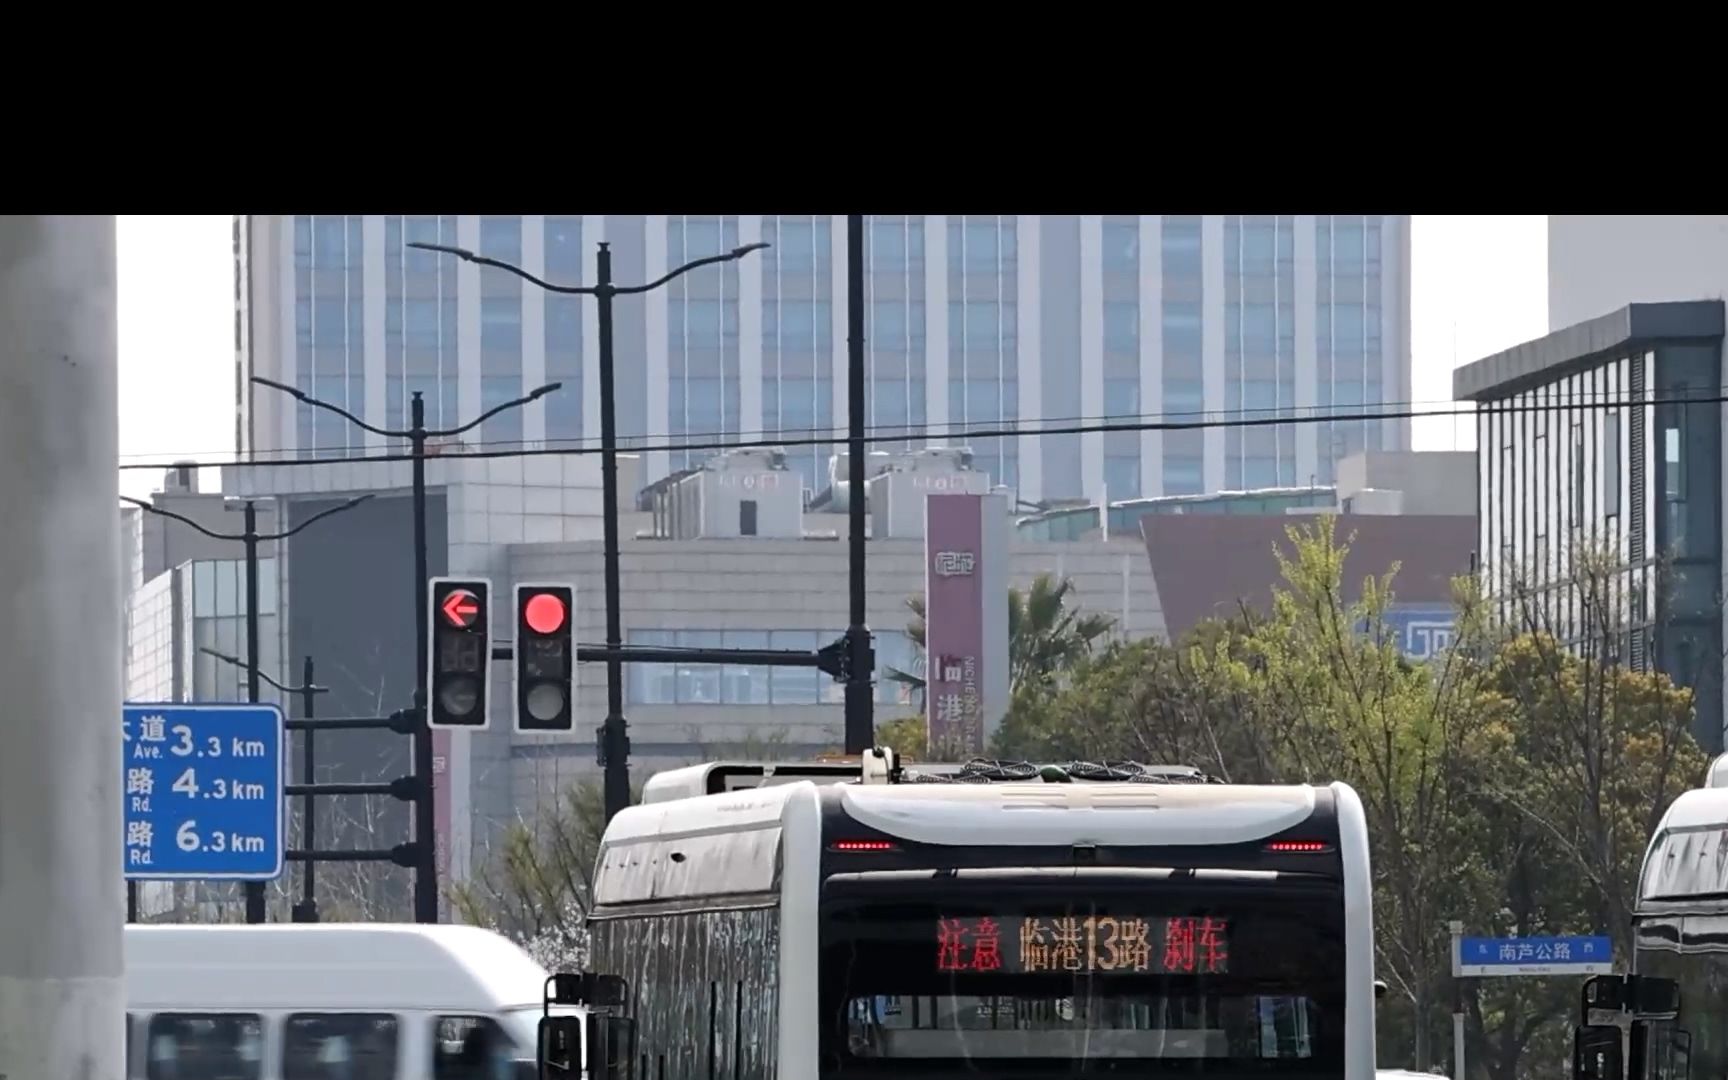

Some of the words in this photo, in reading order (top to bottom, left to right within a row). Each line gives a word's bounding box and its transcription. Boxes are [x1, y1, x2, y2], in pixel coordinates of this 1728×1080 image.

[133, 744, 163, 760] Ave.
[170, 724, 222, 758] 3.3
[232, 737, 265, 758] km
[126, 767, 155, 795] 路
[172, 767, 227, 800] 4.3
[232, 780, 265, 800] km
[132, 797, 153, 812] Rd.
[126, 820, 154, 848] 路
[176, 820, 226, 853] 6.3
[231, 833, 265, 853] km
[130, 849, 154, 865] Rd.
[936, 915, 1001, 972] 注意
[1019, 916, 1151, 972] 临港13路
[1163, 916, 1228, 973] 刹车
[1499, 942, 1571, 960] 南芦公路
